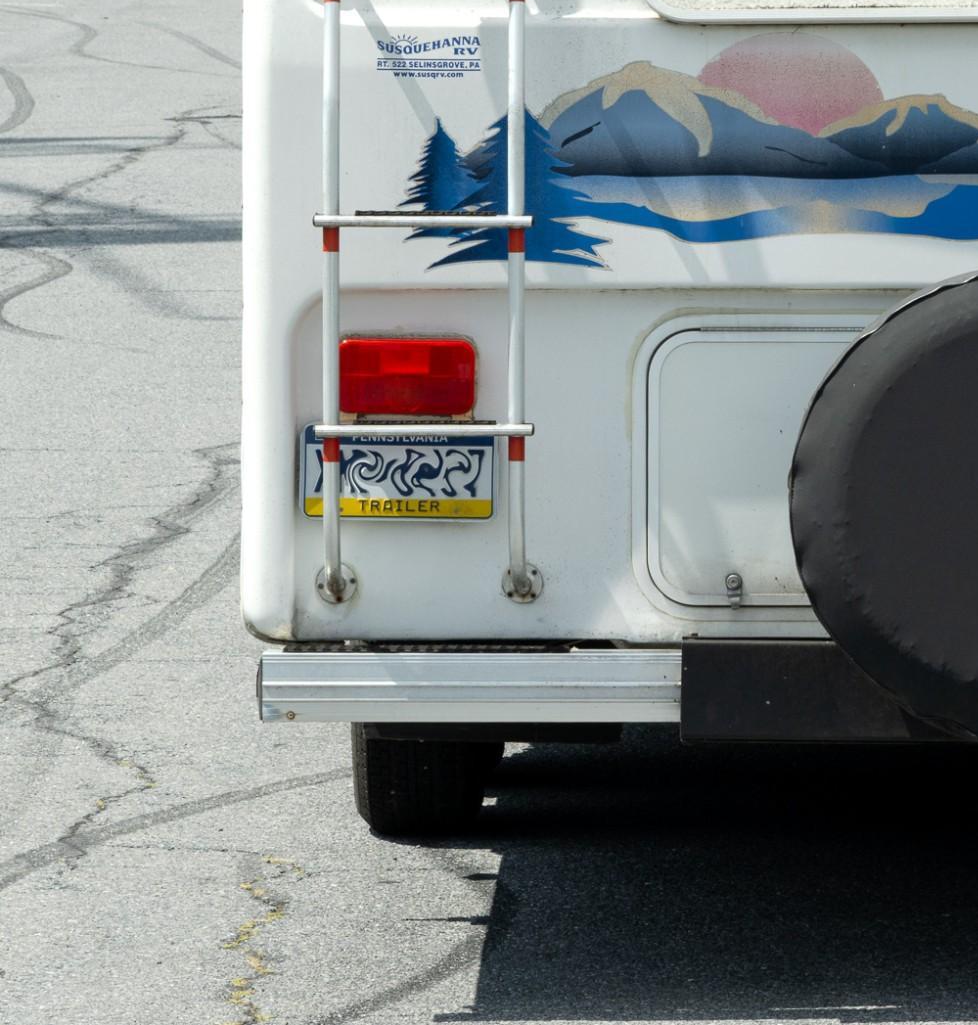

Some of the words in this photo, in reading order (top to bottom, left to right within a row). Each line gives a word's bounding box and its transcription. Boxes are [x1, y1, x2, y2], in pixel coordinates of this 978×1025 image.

[377, 36, 481, 55] SUSQUEHANNA
[453, 47, 478, 55] RV
[393, 71, 464, 79] www.susqrv.com
[359, 500, 440, 513] TRAILER
